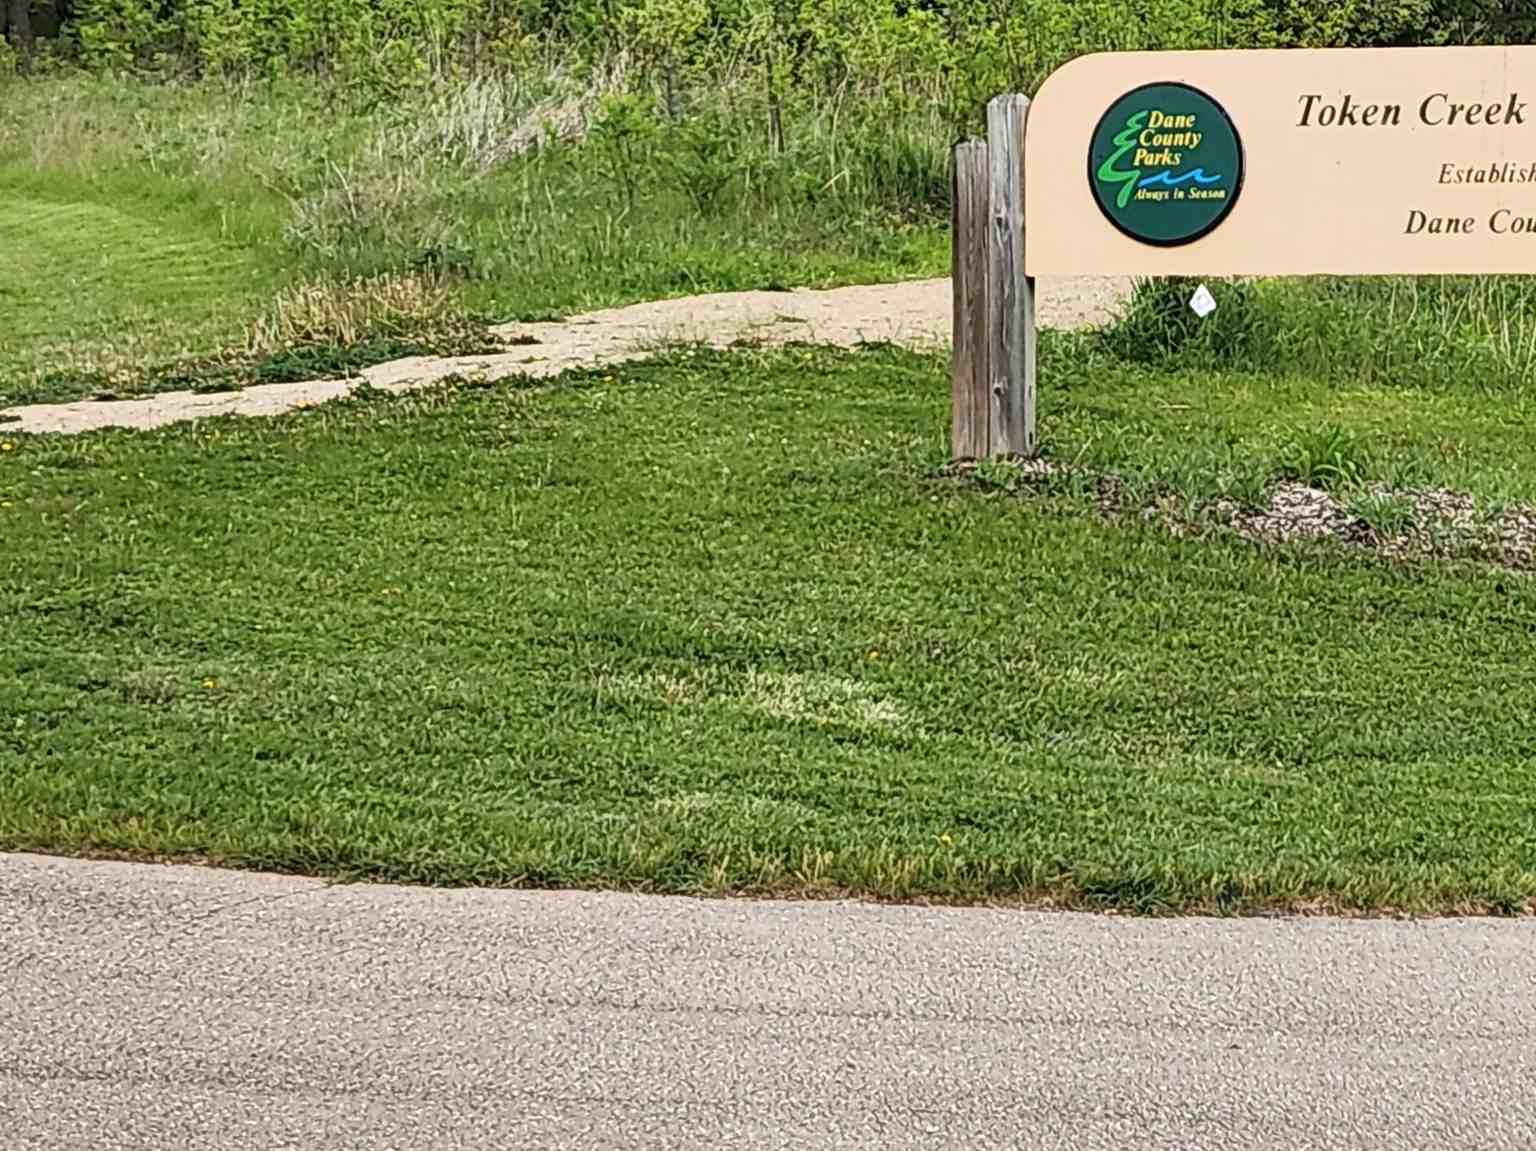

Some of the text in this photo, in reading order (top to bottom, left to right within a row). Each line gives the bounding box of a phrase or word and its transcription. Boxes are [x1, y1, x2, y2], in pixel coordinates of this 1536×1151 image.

[1295, 94, 1401, 127] Token
[1419, 92, 1527, 126] Creek
[1148, 110, 1196, 129] Dane
[1139, 129, 1202, 149] County
[1133, 148, 1182, 166] Parks
[1134, 188, 1169, 200] Always
[1188, 187, 1225, 200] Season
[1404, 210, 1475, 234] Dane
